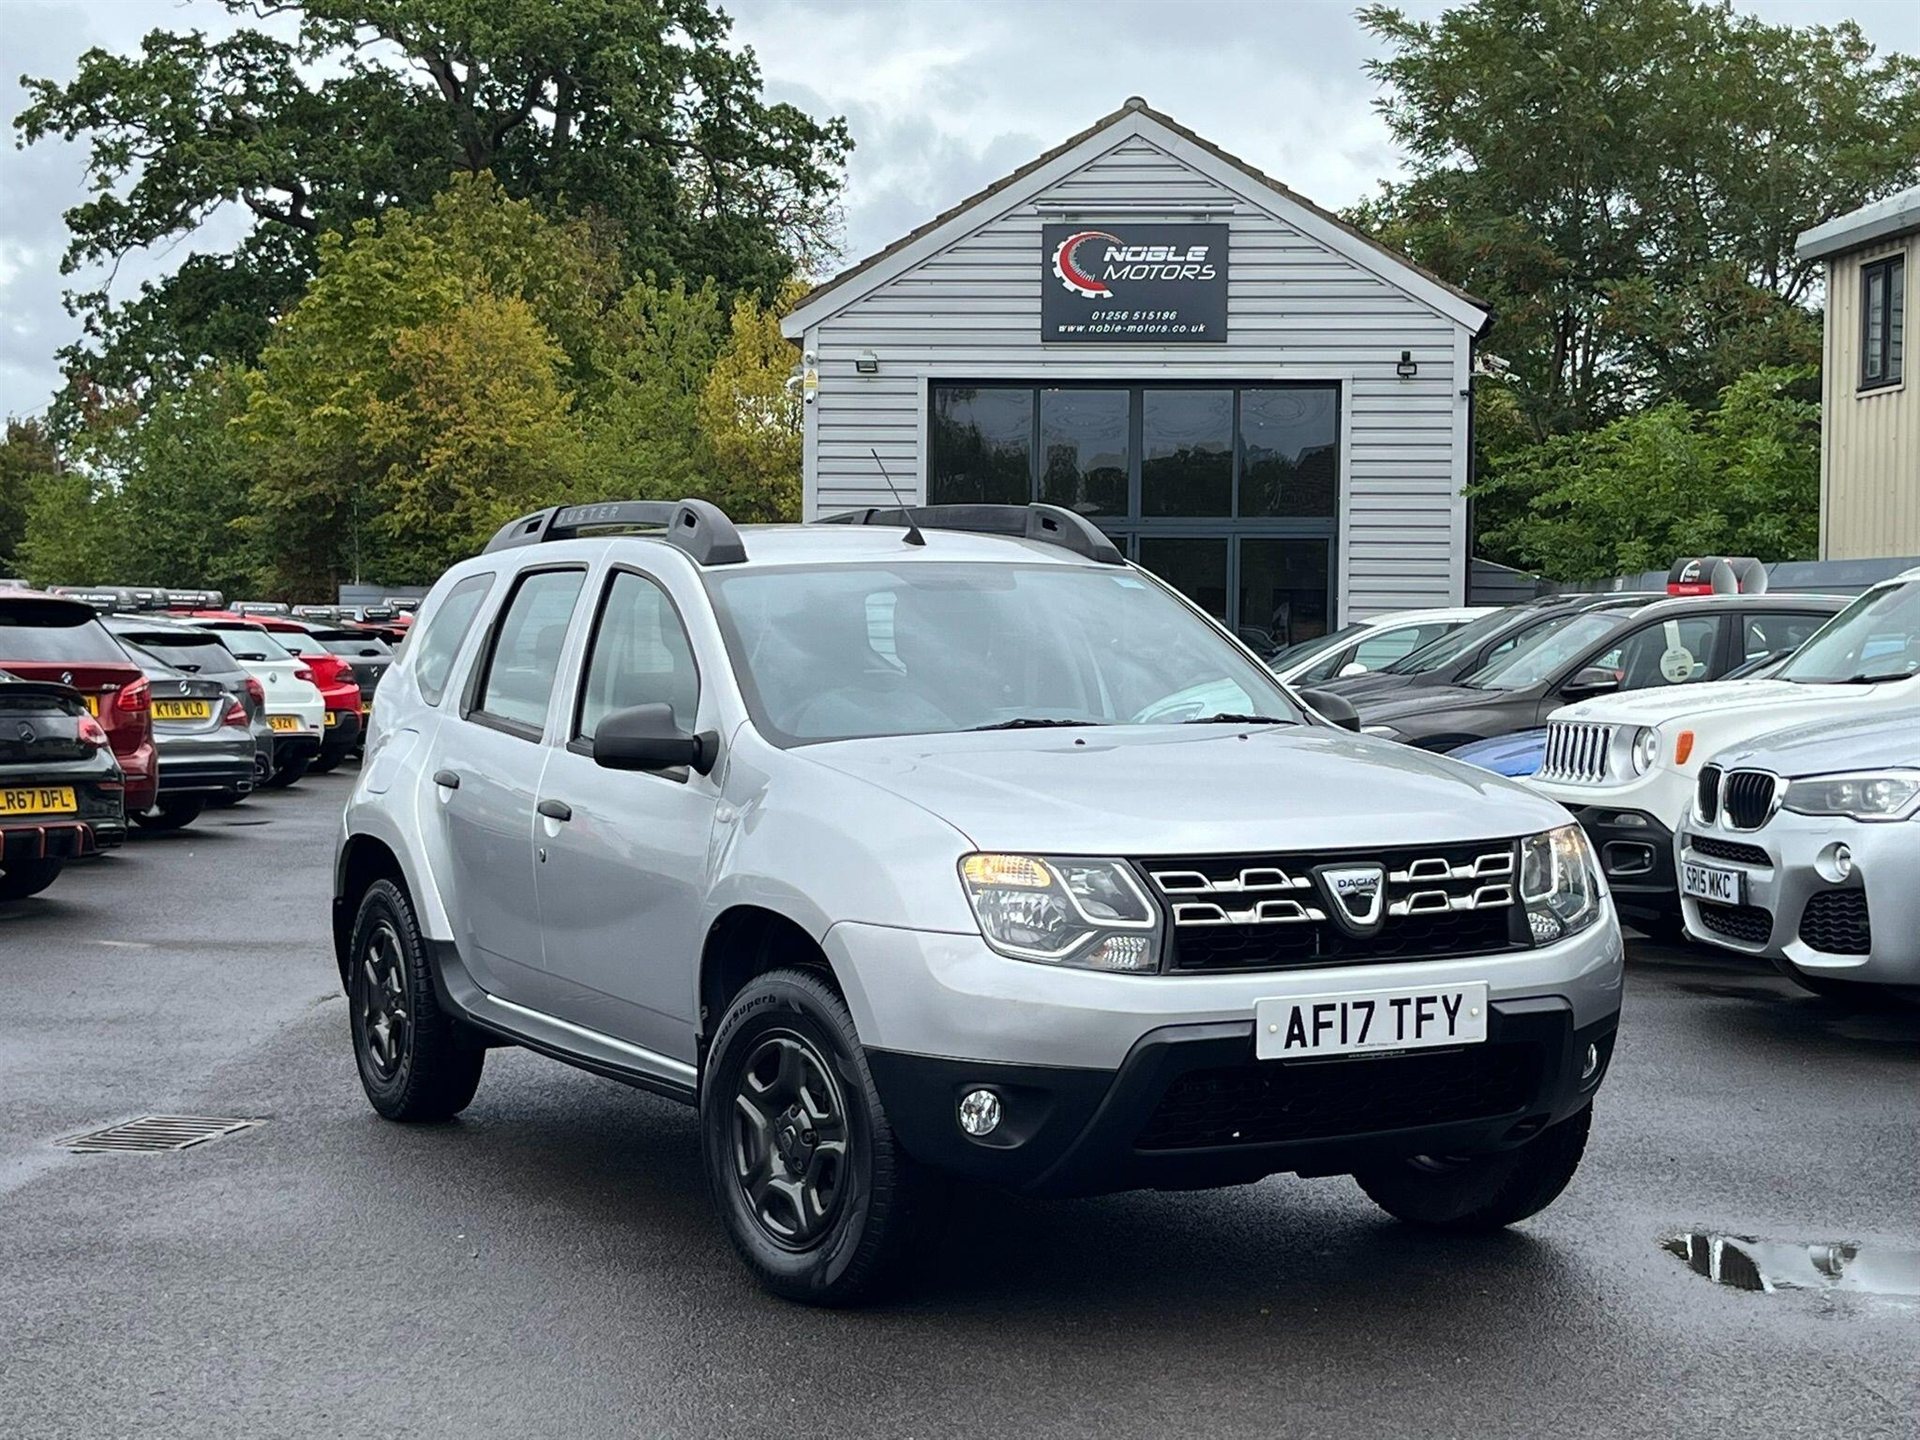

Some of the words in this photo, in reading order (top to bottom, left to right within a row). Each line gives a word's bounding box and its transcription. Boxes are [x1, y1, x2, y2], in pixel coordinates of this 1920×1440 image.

[1103, 246, 1209, 262] NOBLE
[1103, 264, 1216, 280] MOTORS
[1091, 310, 1128, 321] 01256
[1058, 323, 1206, 333] www.noble-motors.co.uk
[556, 505, 619, 525] DUSTER
[156, 701, 181, 716] KT18
[184, 702, 204, 716] VLO
[41, 790, 70, 808] DFL
[1338, 878, 1378, 888] DACIA
[1686, 866, 1706, 893] SR15
[1284, 1001, 1376, 1050] AF17
[1389, 993, 1463, 1041] TFY
